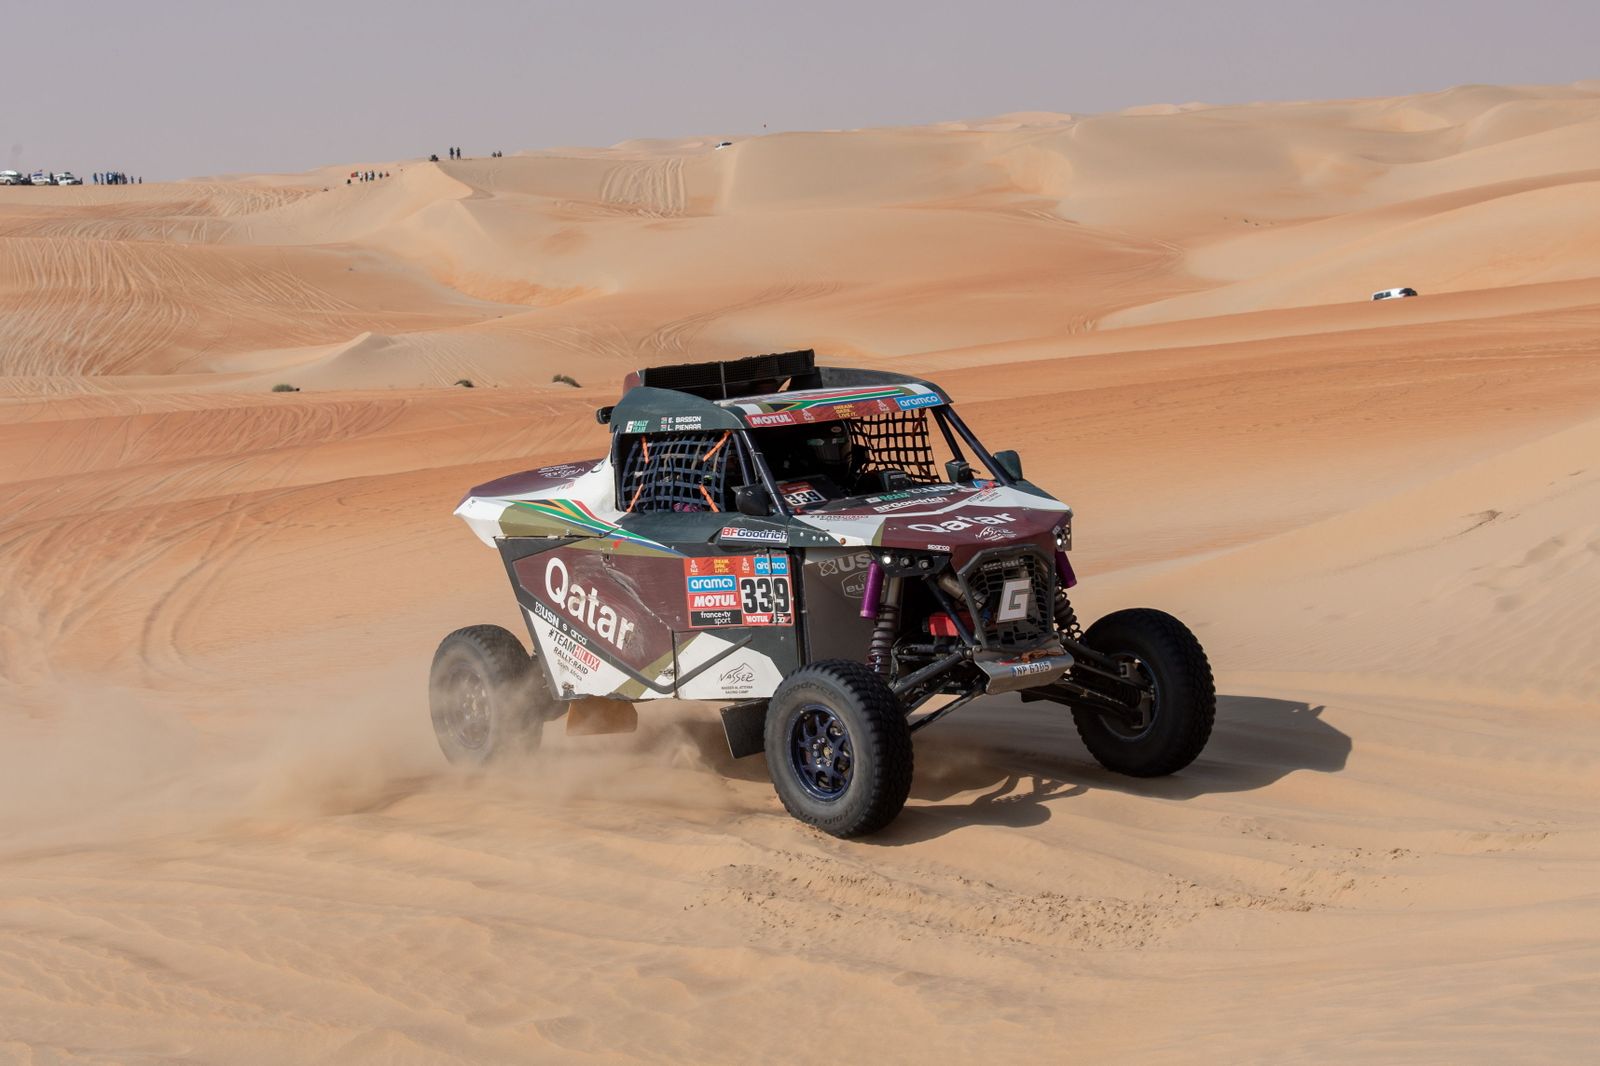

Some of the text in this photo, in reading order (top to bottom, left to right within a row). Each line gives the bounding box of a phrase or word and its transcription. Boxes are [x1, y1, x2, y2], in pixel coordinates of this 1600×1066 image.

[900, 396, 938, 406] aramco
[752, 413, 792, 425] MOTUL
[785, 490, 821, 504] 339
[873, 496, 948, 510] BFGoodrich
[908, 512, 1016, 532] Qatar
[722, 528, 787, 540] BFGoodrich
[838, 553, 873, 572] US
[694, 594, 736, 607] MOTUL
[741, 578, 790, 613] 339
[545, 557, 634, 650] Qatar
[541, 607, 560, 628] USN
[714, 618, 731, 626] sport
[548, 628, 602, 672] #TEAMHILUX
